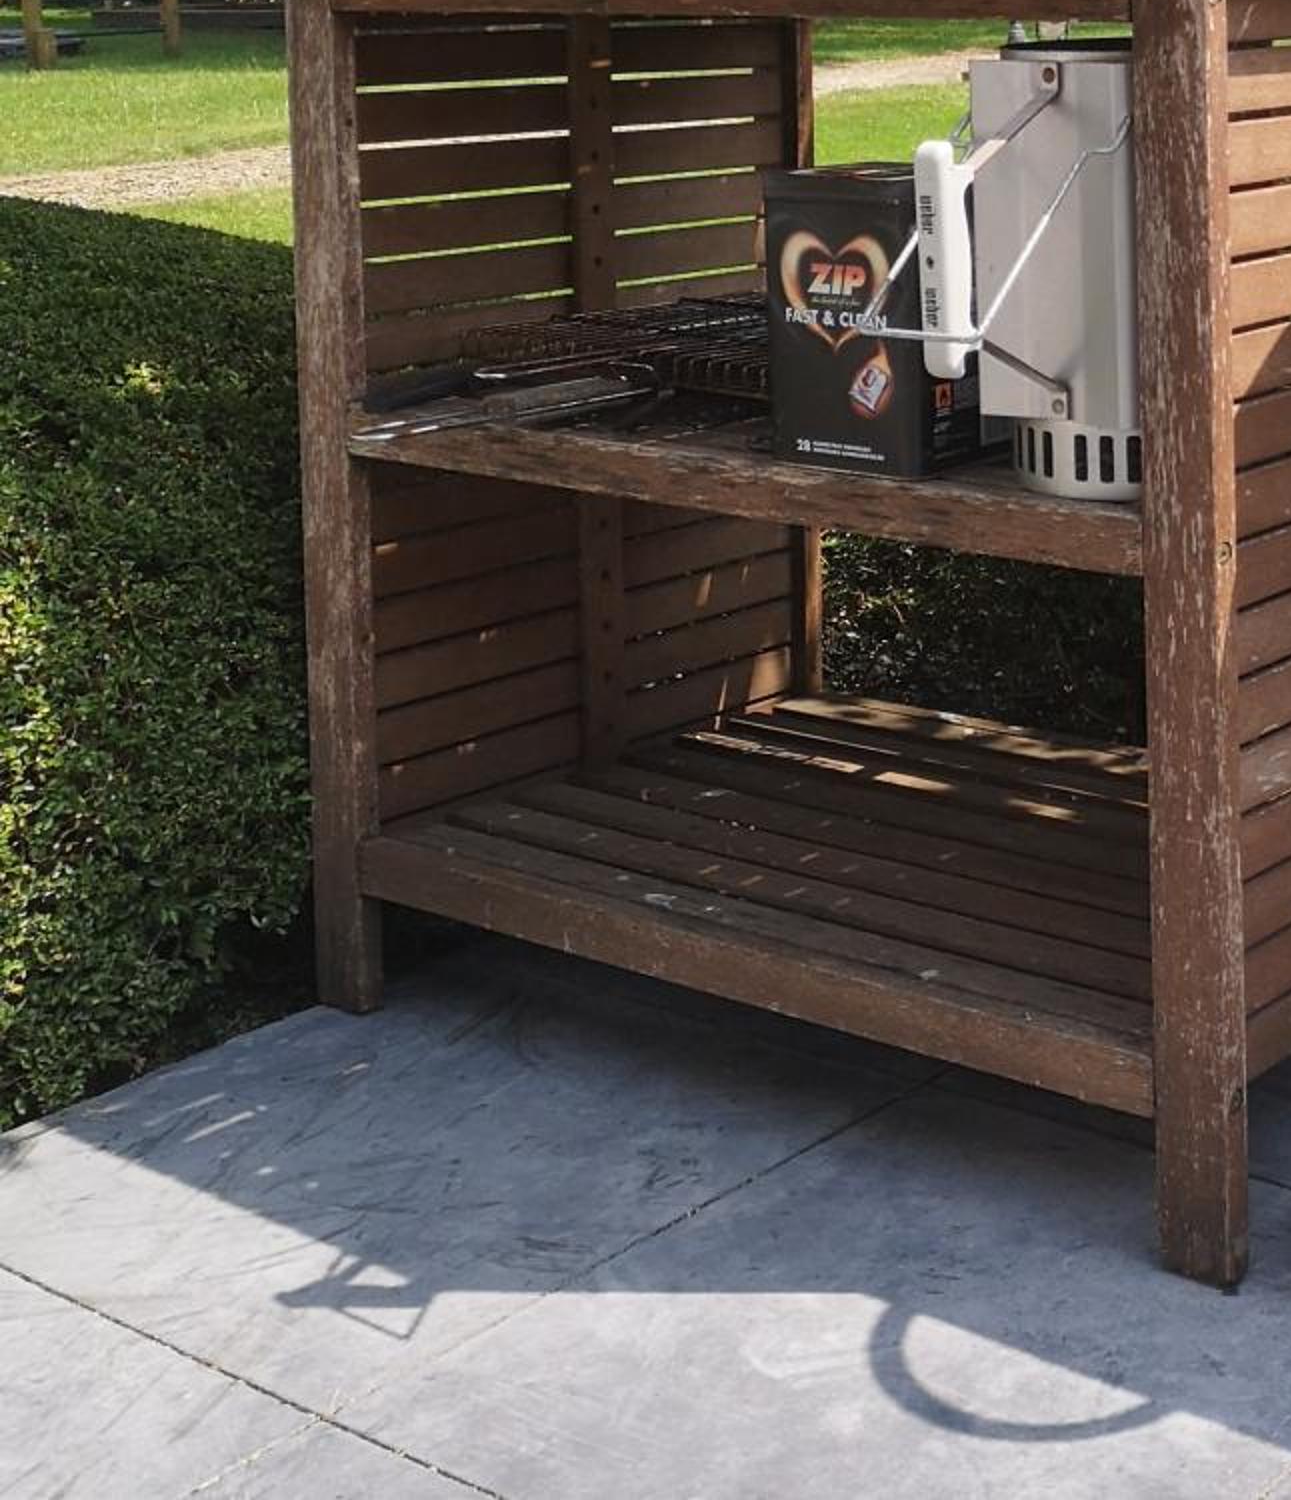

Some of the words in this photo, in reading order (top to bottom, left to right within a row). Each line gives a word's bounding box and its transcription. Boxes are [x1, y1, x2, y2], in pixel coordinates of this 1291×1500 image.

[807, 263, 867, 296] ZIP
[785, 307, 819, 325] FAST
[822, 311, 836, 328] &
